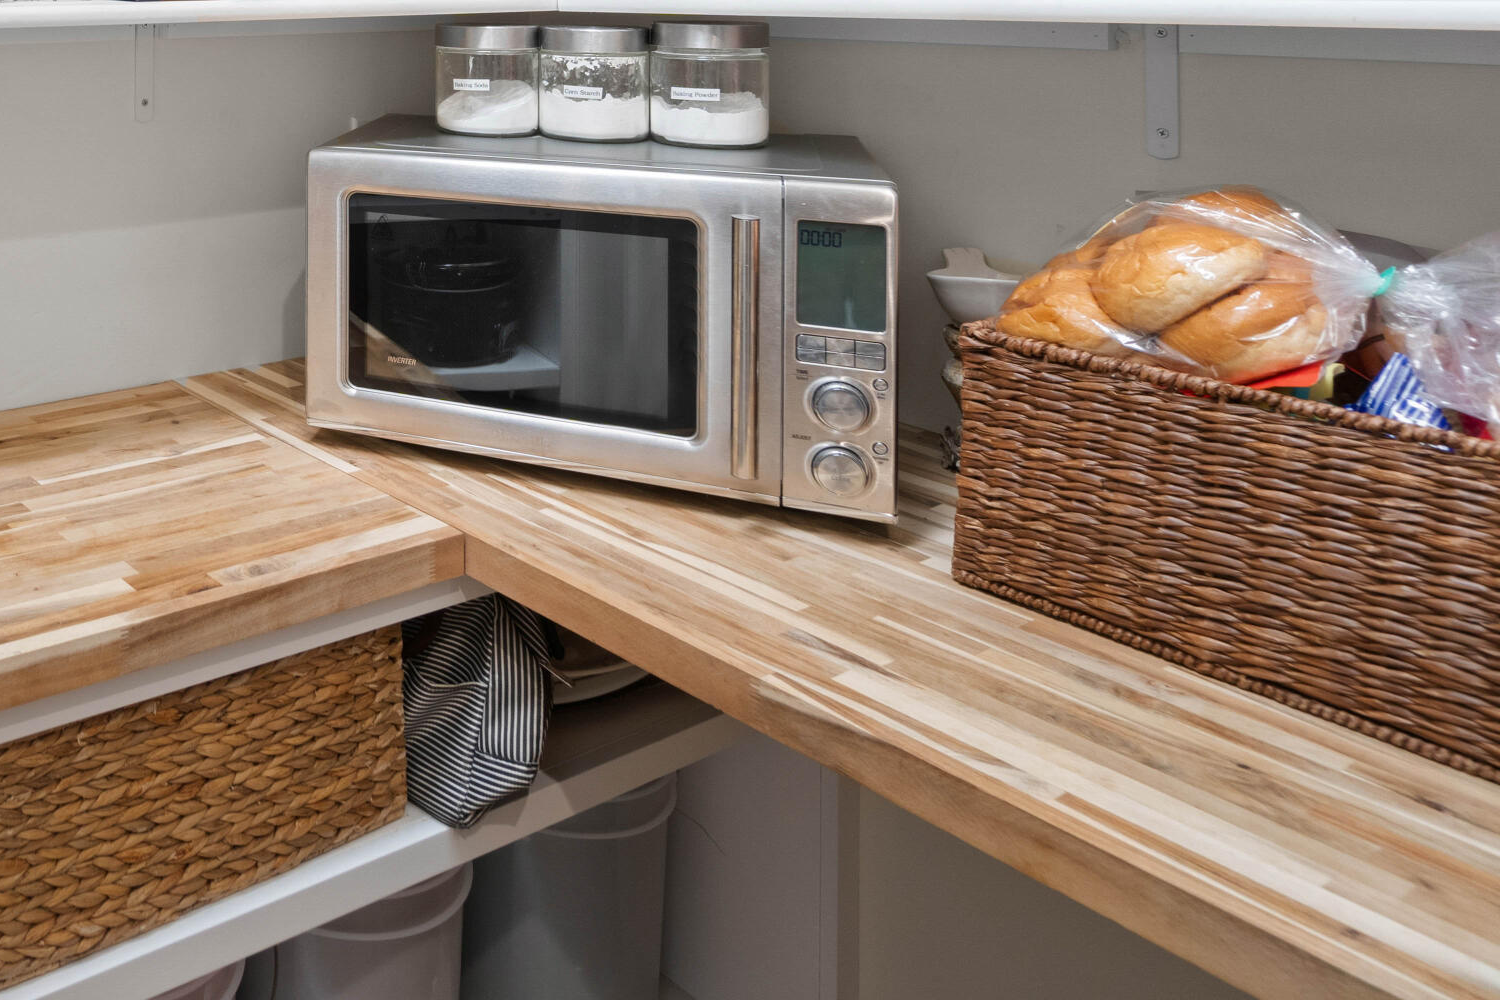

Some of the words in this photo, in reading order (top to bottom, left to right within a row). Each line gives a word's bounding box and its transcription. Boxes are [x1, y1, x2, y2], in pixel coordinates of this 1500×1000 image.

[564, 87, 578, 95] Corn
[579, 89, 601, 97] Starch
[672, 90, 692, 99] Baking
